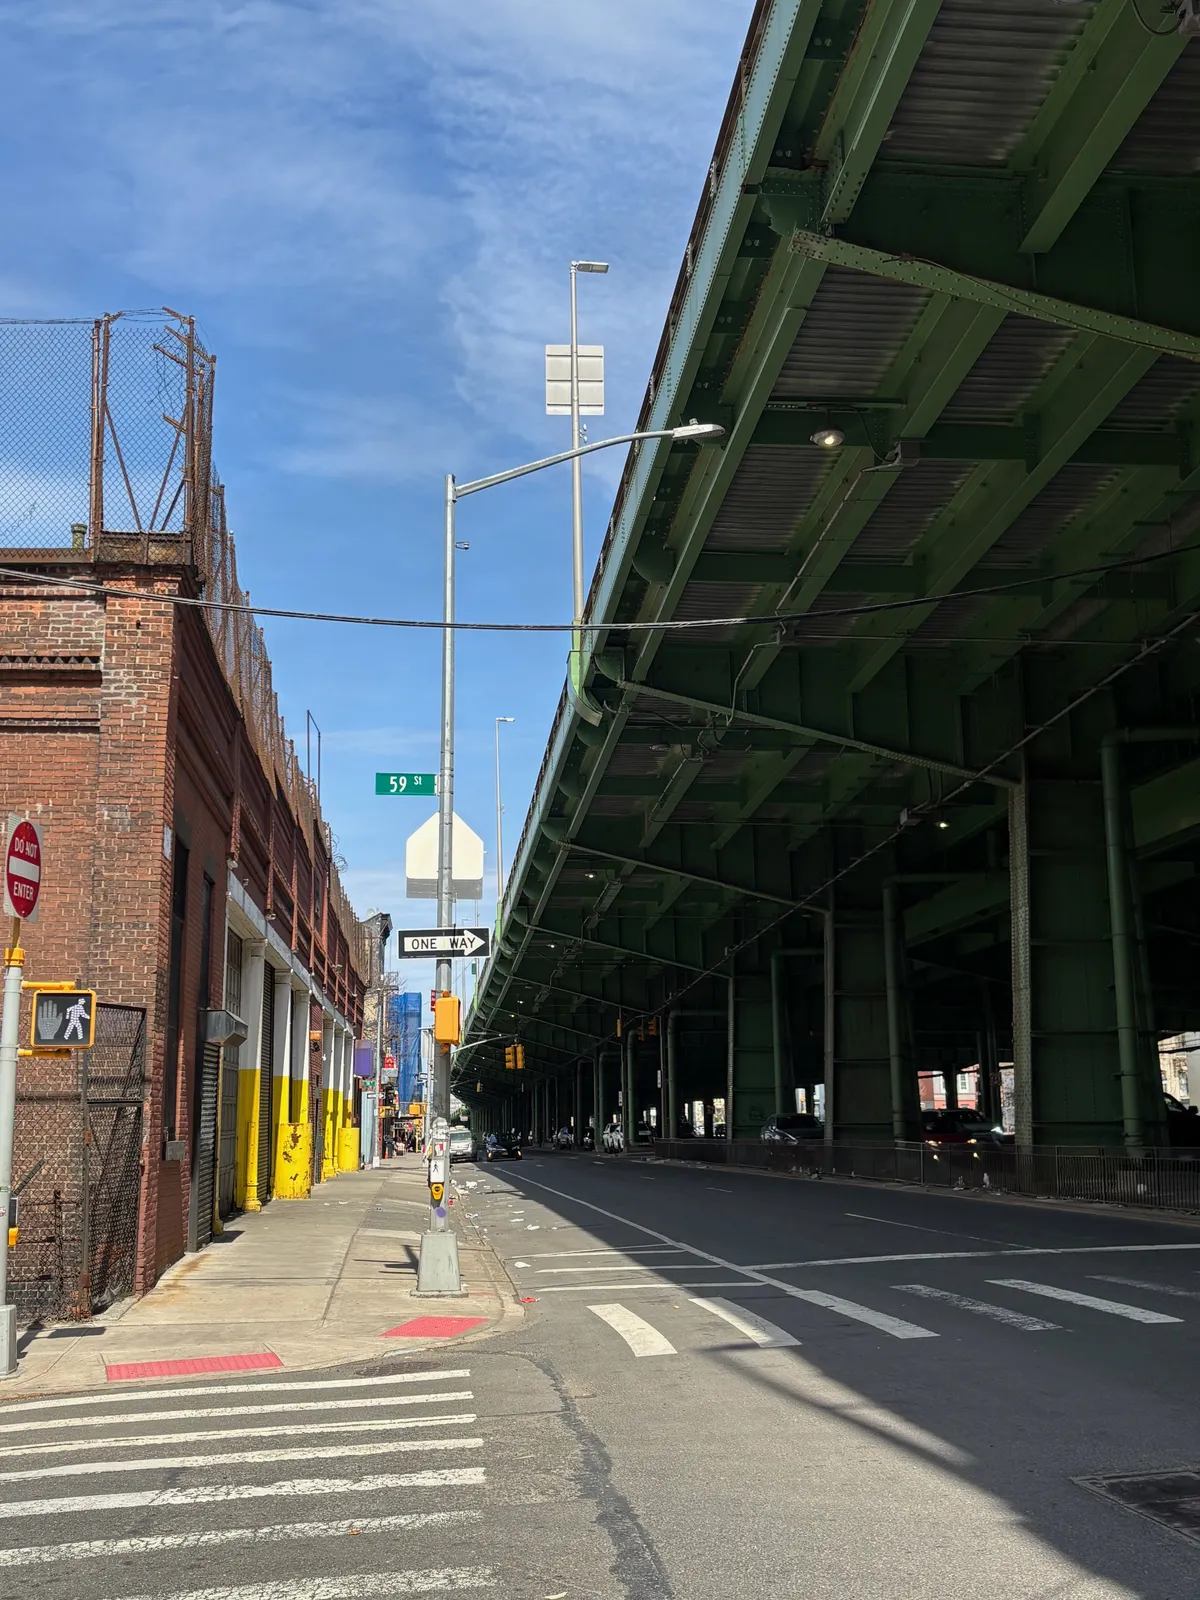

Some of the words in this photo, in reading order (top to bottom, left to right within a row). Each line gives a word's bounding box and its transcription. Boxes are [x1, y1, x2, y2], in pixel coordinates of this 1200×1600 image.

[390, 776, 407, 793] 59
[414, 775, 422, 785] St
[14, 837, 25, 853] DO
[25, 841, 38, 859] NOT
[13, 881, 34, 901] ENTER
[411, 938, 437, 950] ONE
[449, 937, 476, 949] WAY
